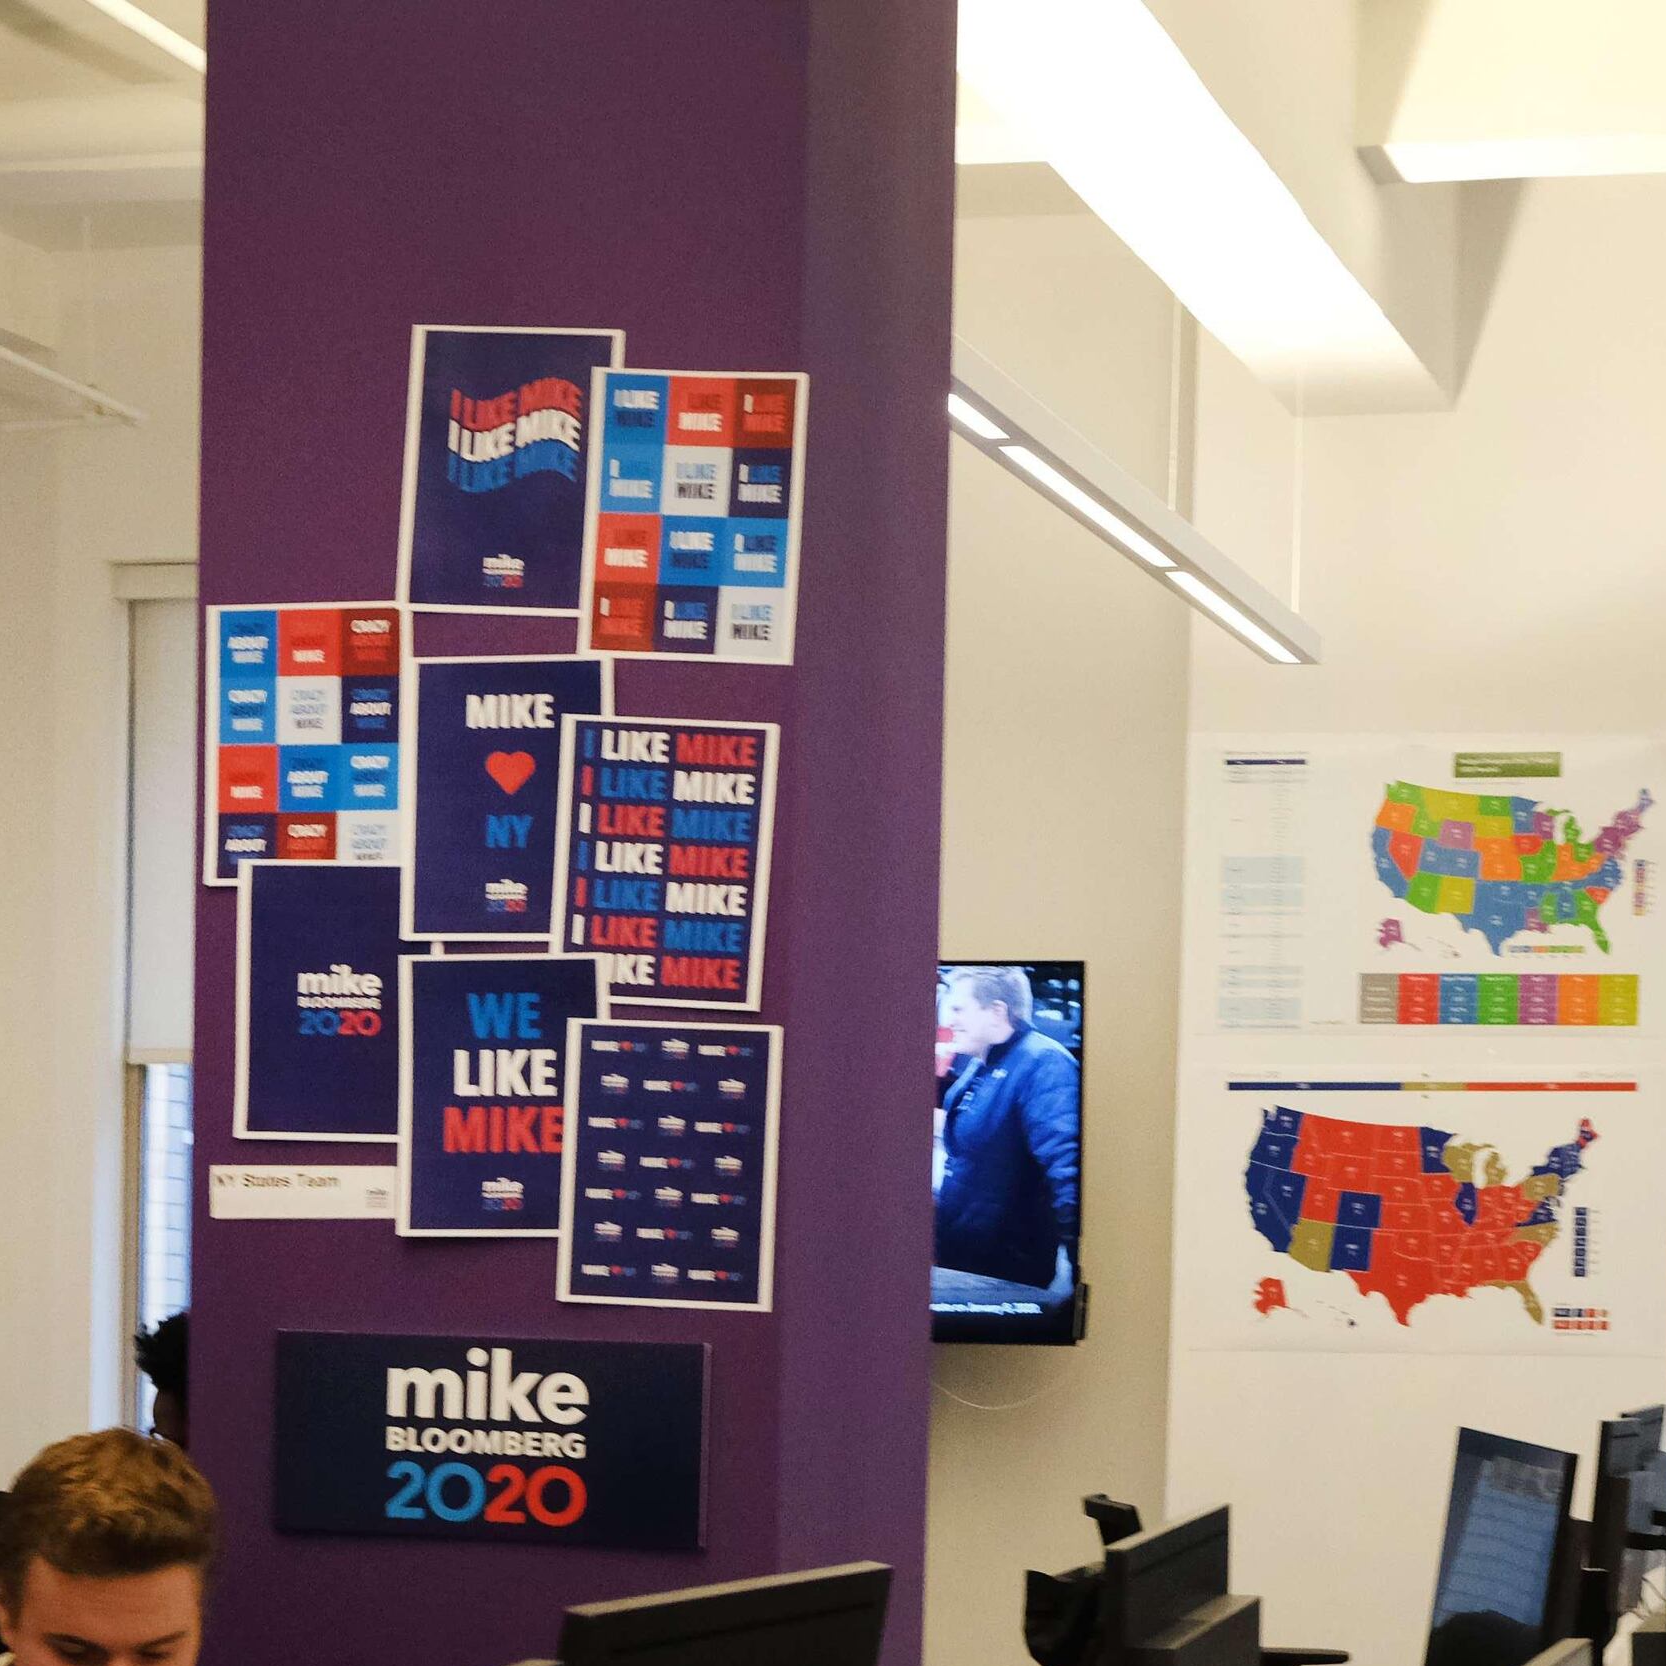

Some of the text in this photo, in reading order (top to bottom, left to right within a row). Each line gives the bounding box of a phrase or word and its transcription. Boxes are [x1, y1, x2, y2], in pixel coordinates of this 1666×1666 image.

[463, 391, 516, 432] LIKE
[519, 377, 583, 418] MIKE
[448, 409, 582, 462] I LIKE MIKE
[466, 694, 555, 729] MIKE
[584, 728, 757, 767] I LIKE MIKE
[581, 765, 756, 805] I LIKE MIKE
[486, 815, 533, 848] NY
[579, 803, 752, 843] I LIKE MIKE
[577, 840, 749, 879] I LIKE MIKE
[575, 877, 748, 917] I LIKE MIKE
[572, 914, 745, 953] I LIKE MIKE
[297, 964, 382, 996] mike
[610, 954, 740, 990] IKE MIKE
[299, 1009, 381, 1036] 2020
[468, 992, 542, 1040] WE
[453, 1049, 558, 1097] LIKE
[443, 1106, 564, 1153] MIKE
[386, 1347, 590, 1426] mike
[385, 1426, 587, 1459] BLOOMBERG
[385, 1460, 588, 1528] 2020
